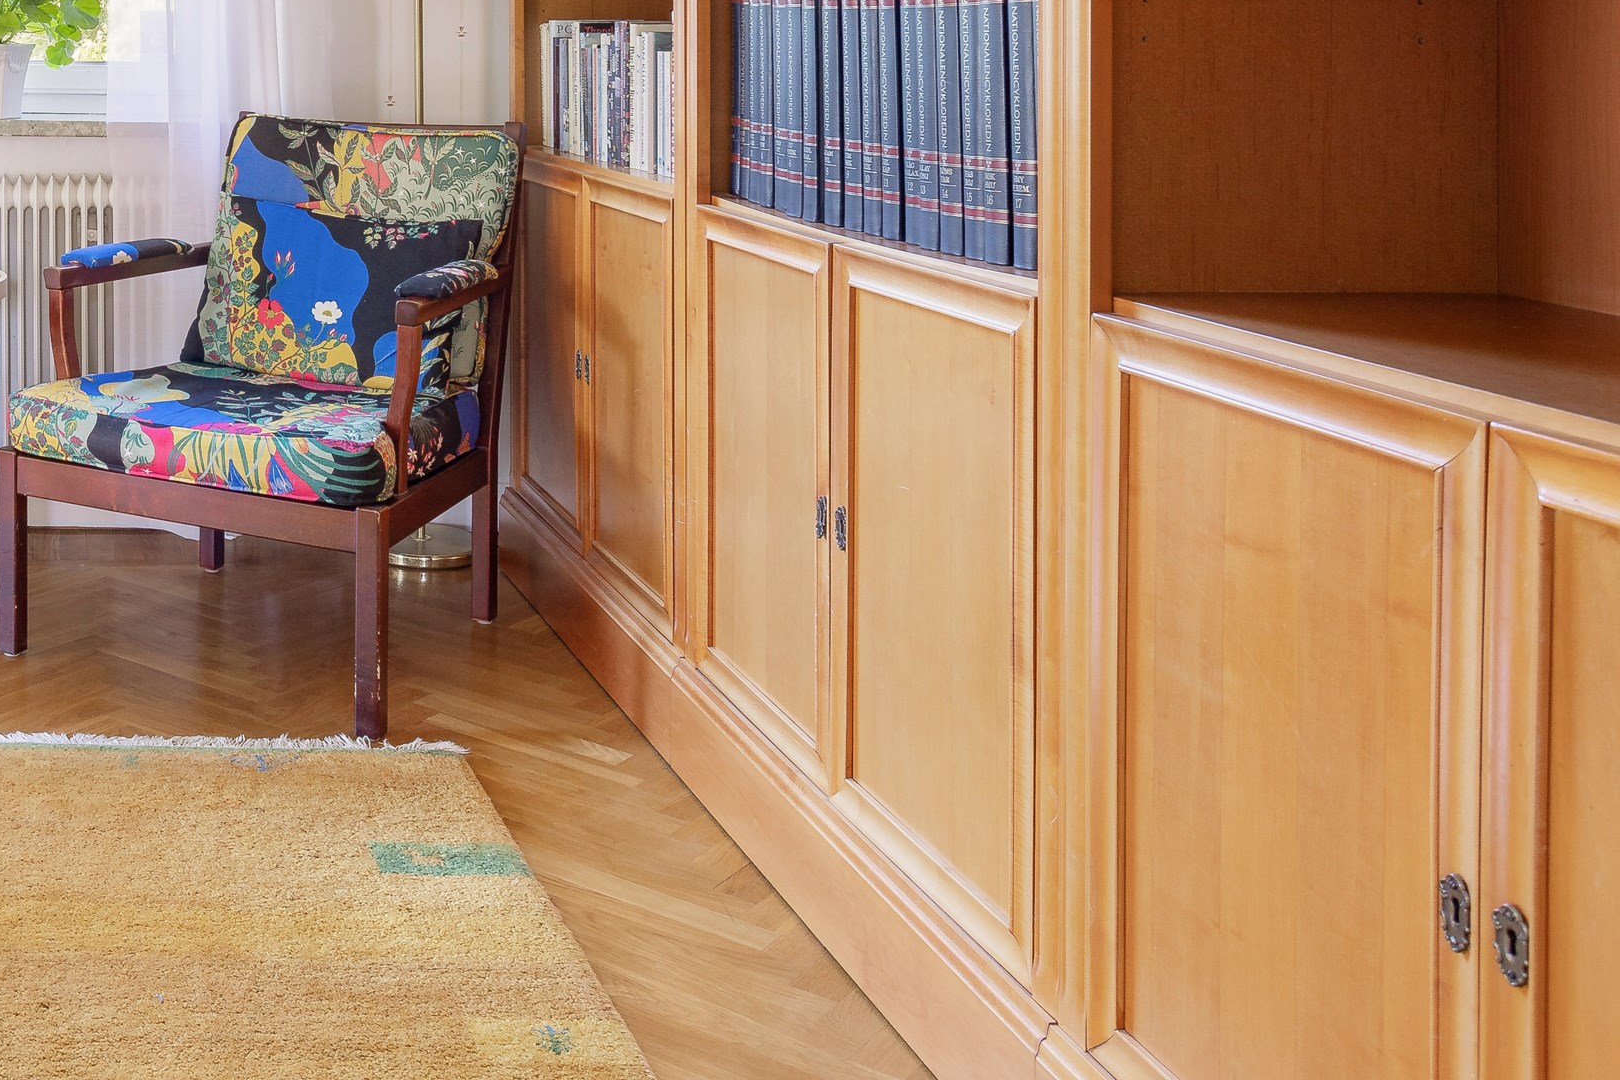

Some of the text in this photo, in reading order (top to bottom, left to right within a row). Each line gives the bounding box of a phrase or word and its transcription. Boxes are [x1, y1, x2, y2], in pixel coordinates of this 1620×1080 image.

[880, 12, 888, 141] NATIONALENCYKLOPEDIN
[903, 11, 913, 143] NATIONALENCYKLOPEDIN
[916, 11, 925, 146] NATIONALENCYKLOPEDIN
[938, 10, 948, 148] NATIONALENCYKLOPEDIN
[962, 9, 972, 151] NATIONALENCYKLOPEDIN
[983, 7, 992, 152] NATIONALENCYKLOPEDIN
[1011, 6, 1022, 154] NATIONALENCYKLOPEDIN
